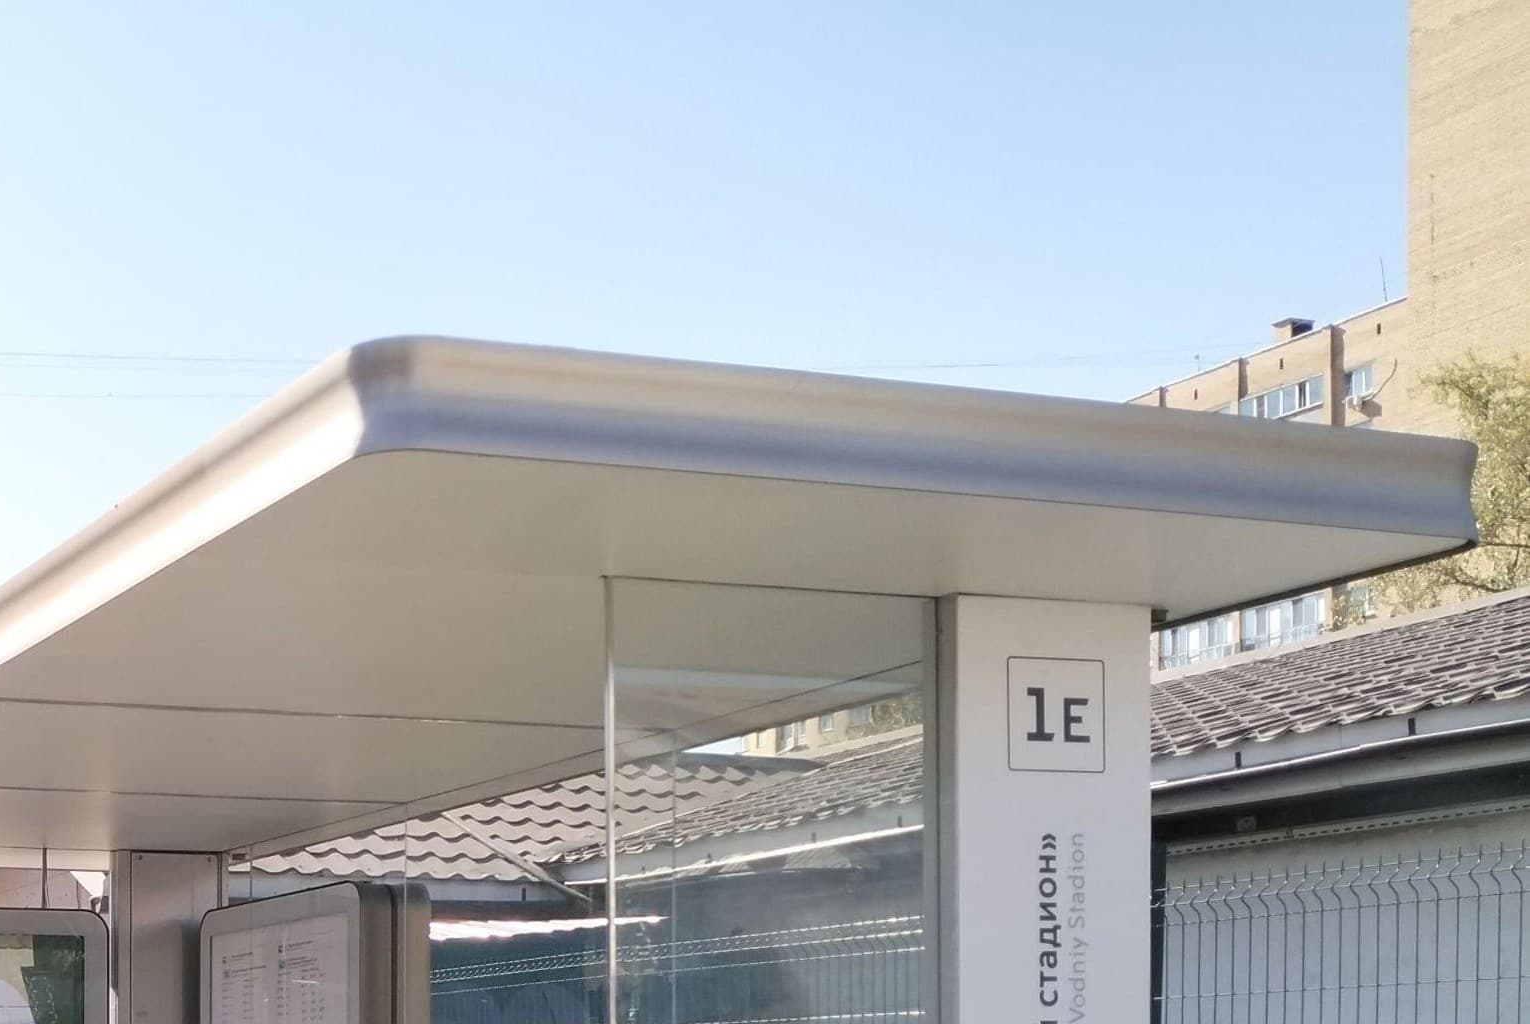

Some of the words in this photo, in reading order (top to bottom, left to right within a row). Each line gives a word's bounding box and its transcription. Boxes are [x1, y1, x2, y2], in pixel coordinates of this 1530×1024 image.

[1038, 833, 1062, 1007] стадион»
[1068, 832, 1086, 929] Stadion
[1067, 935, 1090, 1024] Vodniy
